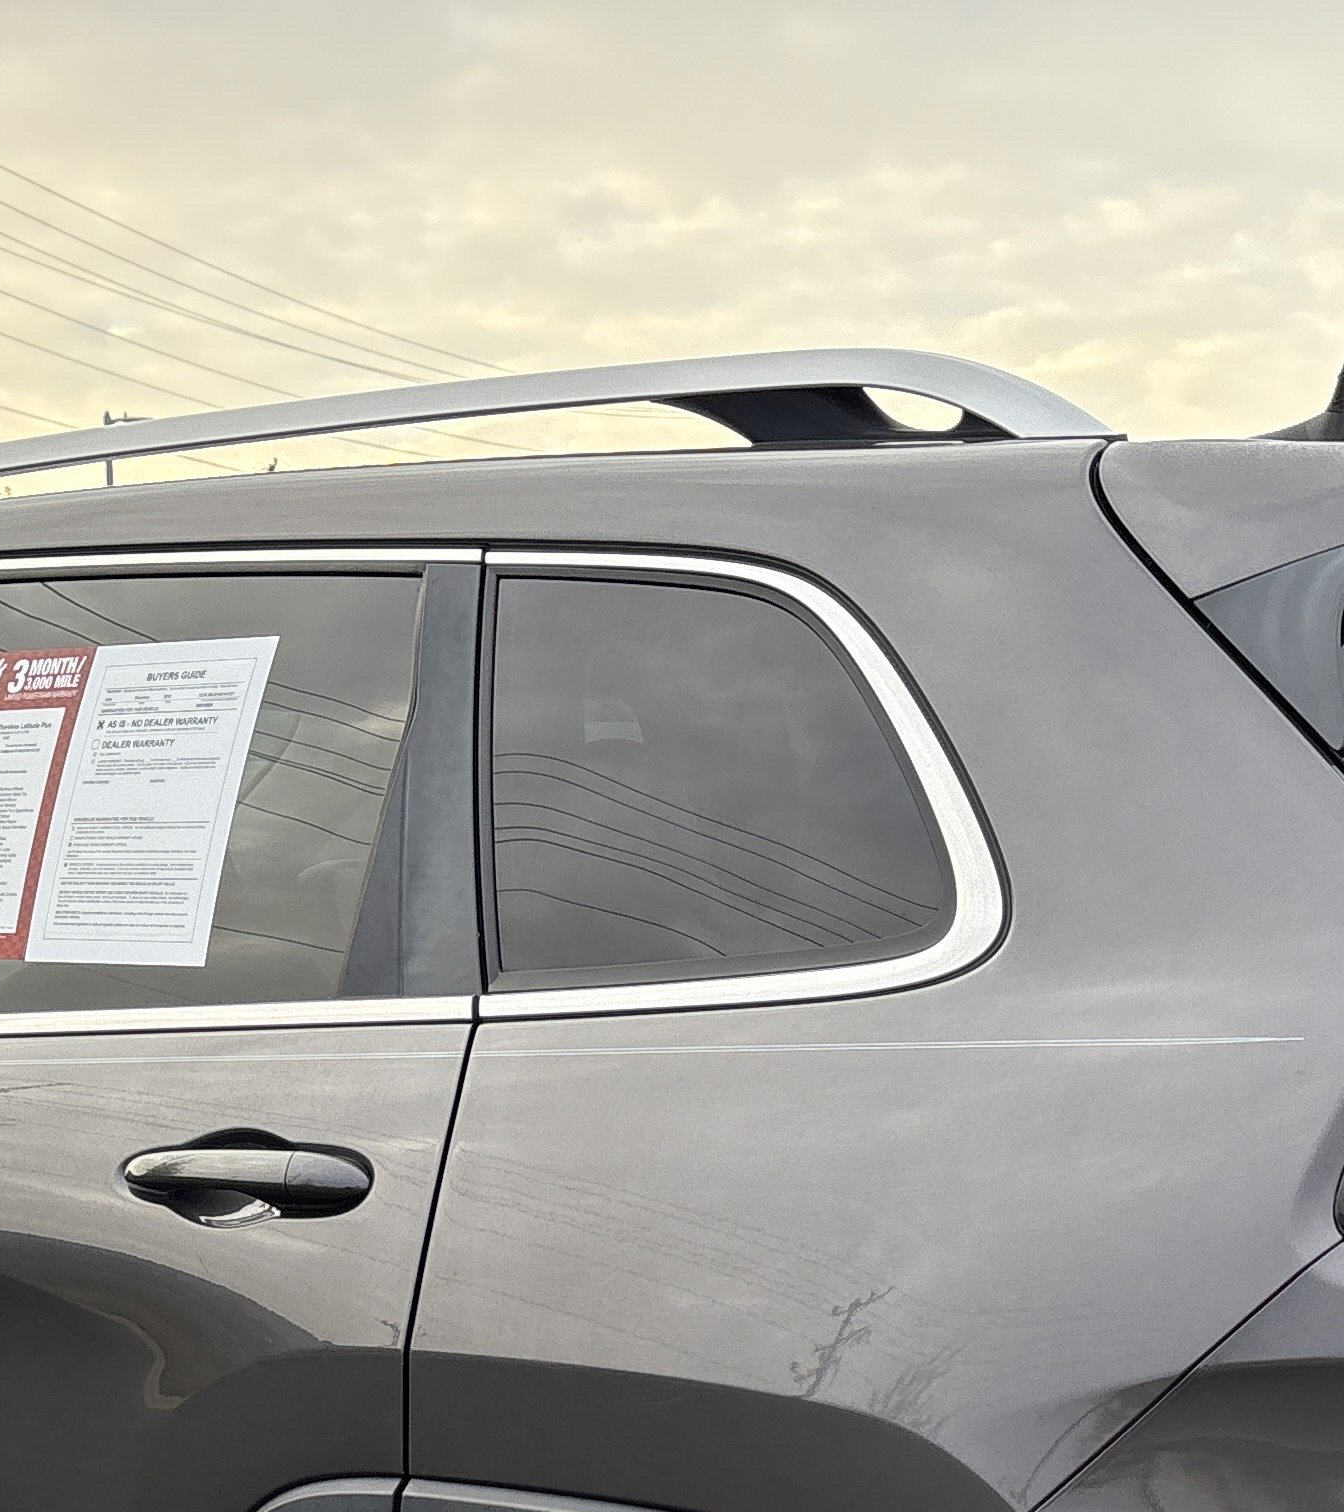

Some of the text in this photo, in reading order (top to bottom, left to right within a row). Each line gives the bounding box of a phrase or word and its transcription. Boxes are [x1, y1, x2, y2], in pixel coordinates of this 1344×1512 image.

[28, 655, 88, 677] MONTH/
[7, 659, 30, 694] 3
[24, 673, 82, 691] 3,000 MILE
[146, 669, 207, 682] BUYERS GUIDE
[107, 720, 117, 728] AS
[118, 719, 127, 728] IS
[131, 719, 142, 727] NO
[143, 717, 174, 727] DEALER
[175, 716, 219, 726] WARRANTY
[101, 738, 175, 750] DEALER WARRANTY
